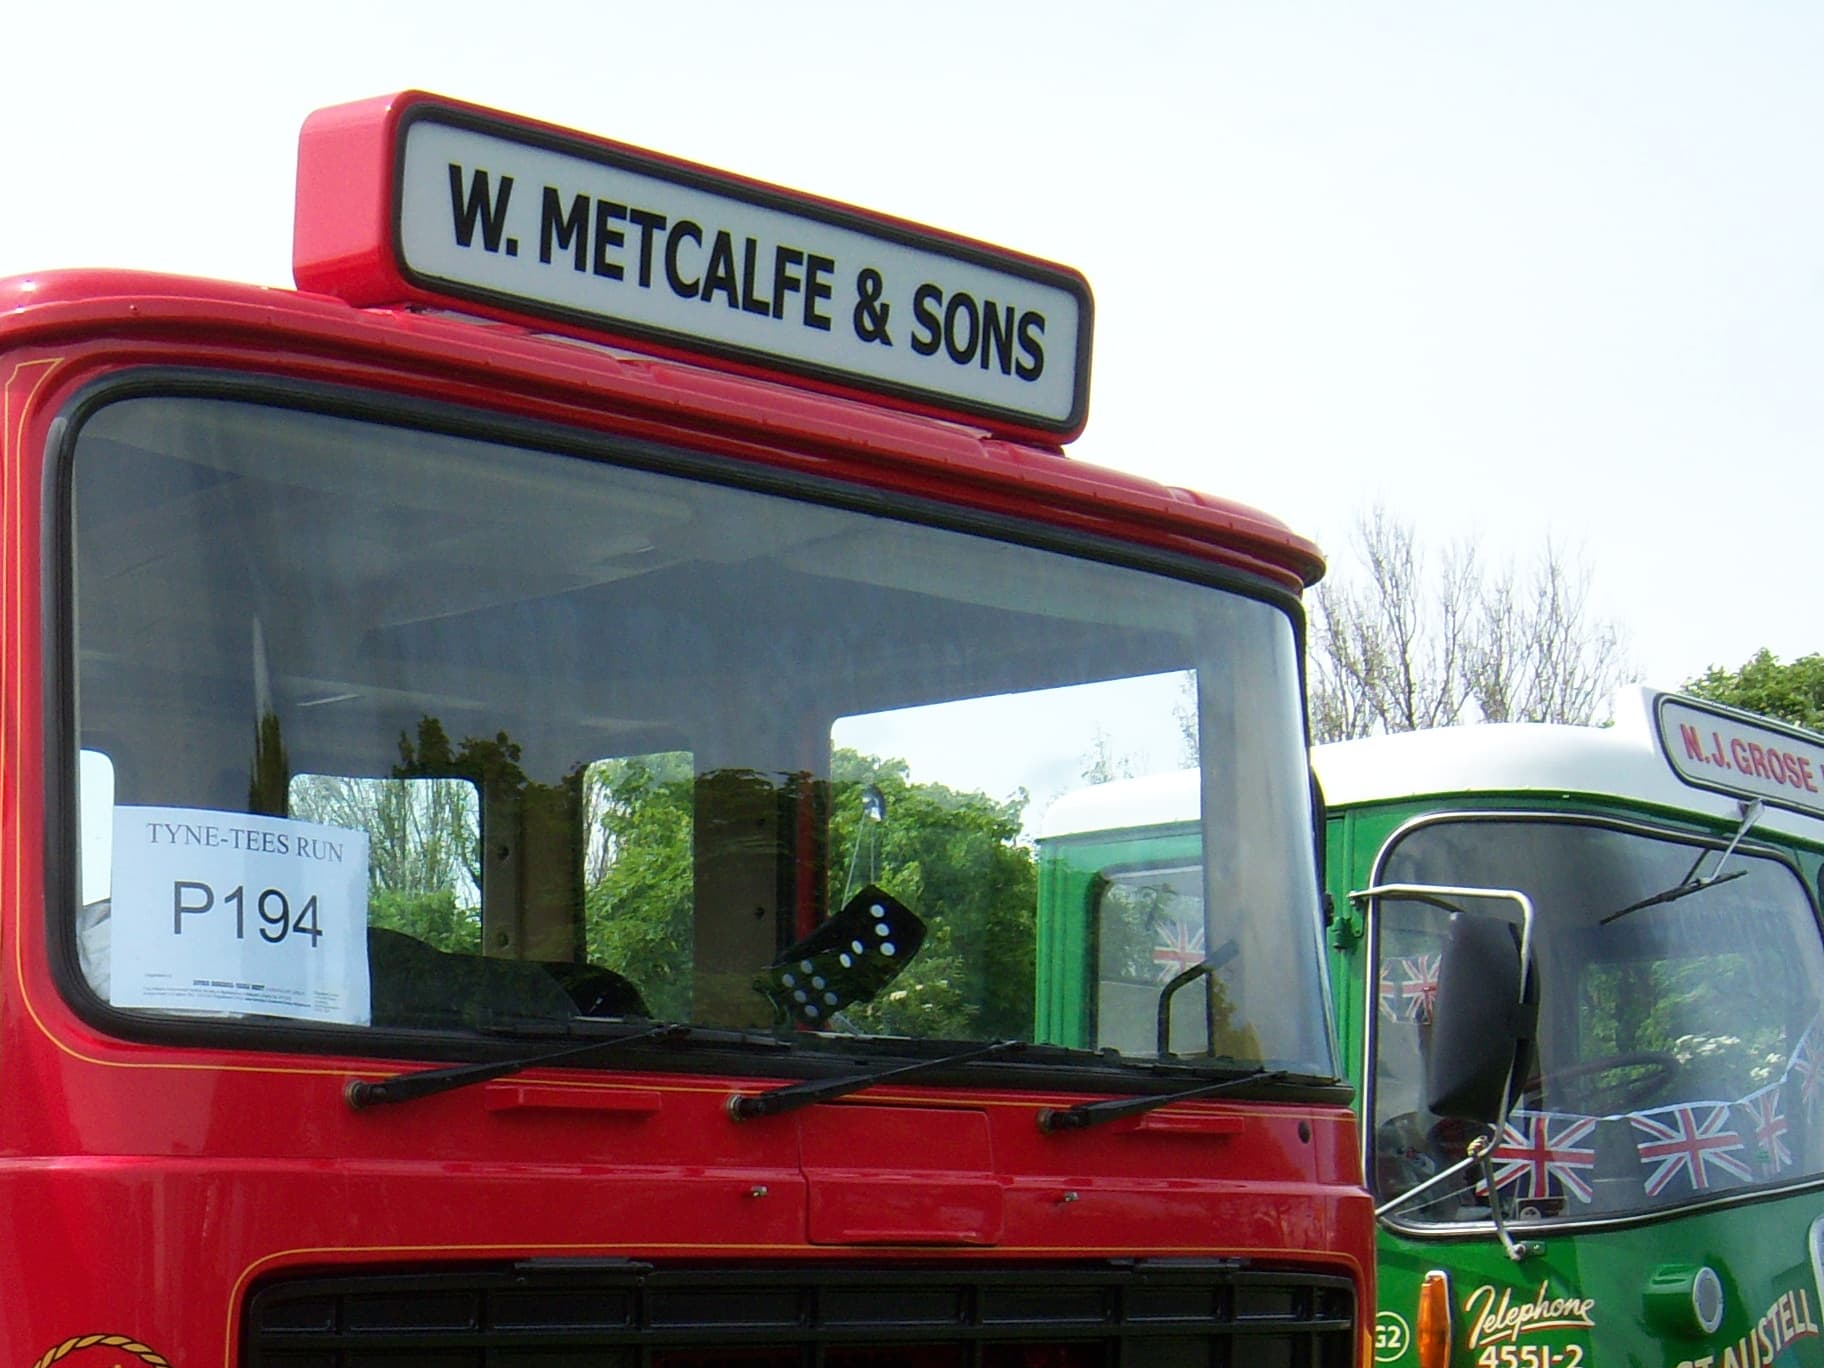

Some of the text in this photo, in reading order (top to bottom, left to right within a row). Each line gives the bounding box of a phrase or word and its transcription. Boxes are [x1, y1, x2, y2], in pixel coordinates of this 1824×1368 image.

[447, 163, 1047, 383] W. METCALFE & SONS
[146, 822, 344, 863] TYNE-TEES RUN
[173, 880, 324, 948] P194
[1464, 1280, 1597, 1350] Telephone
